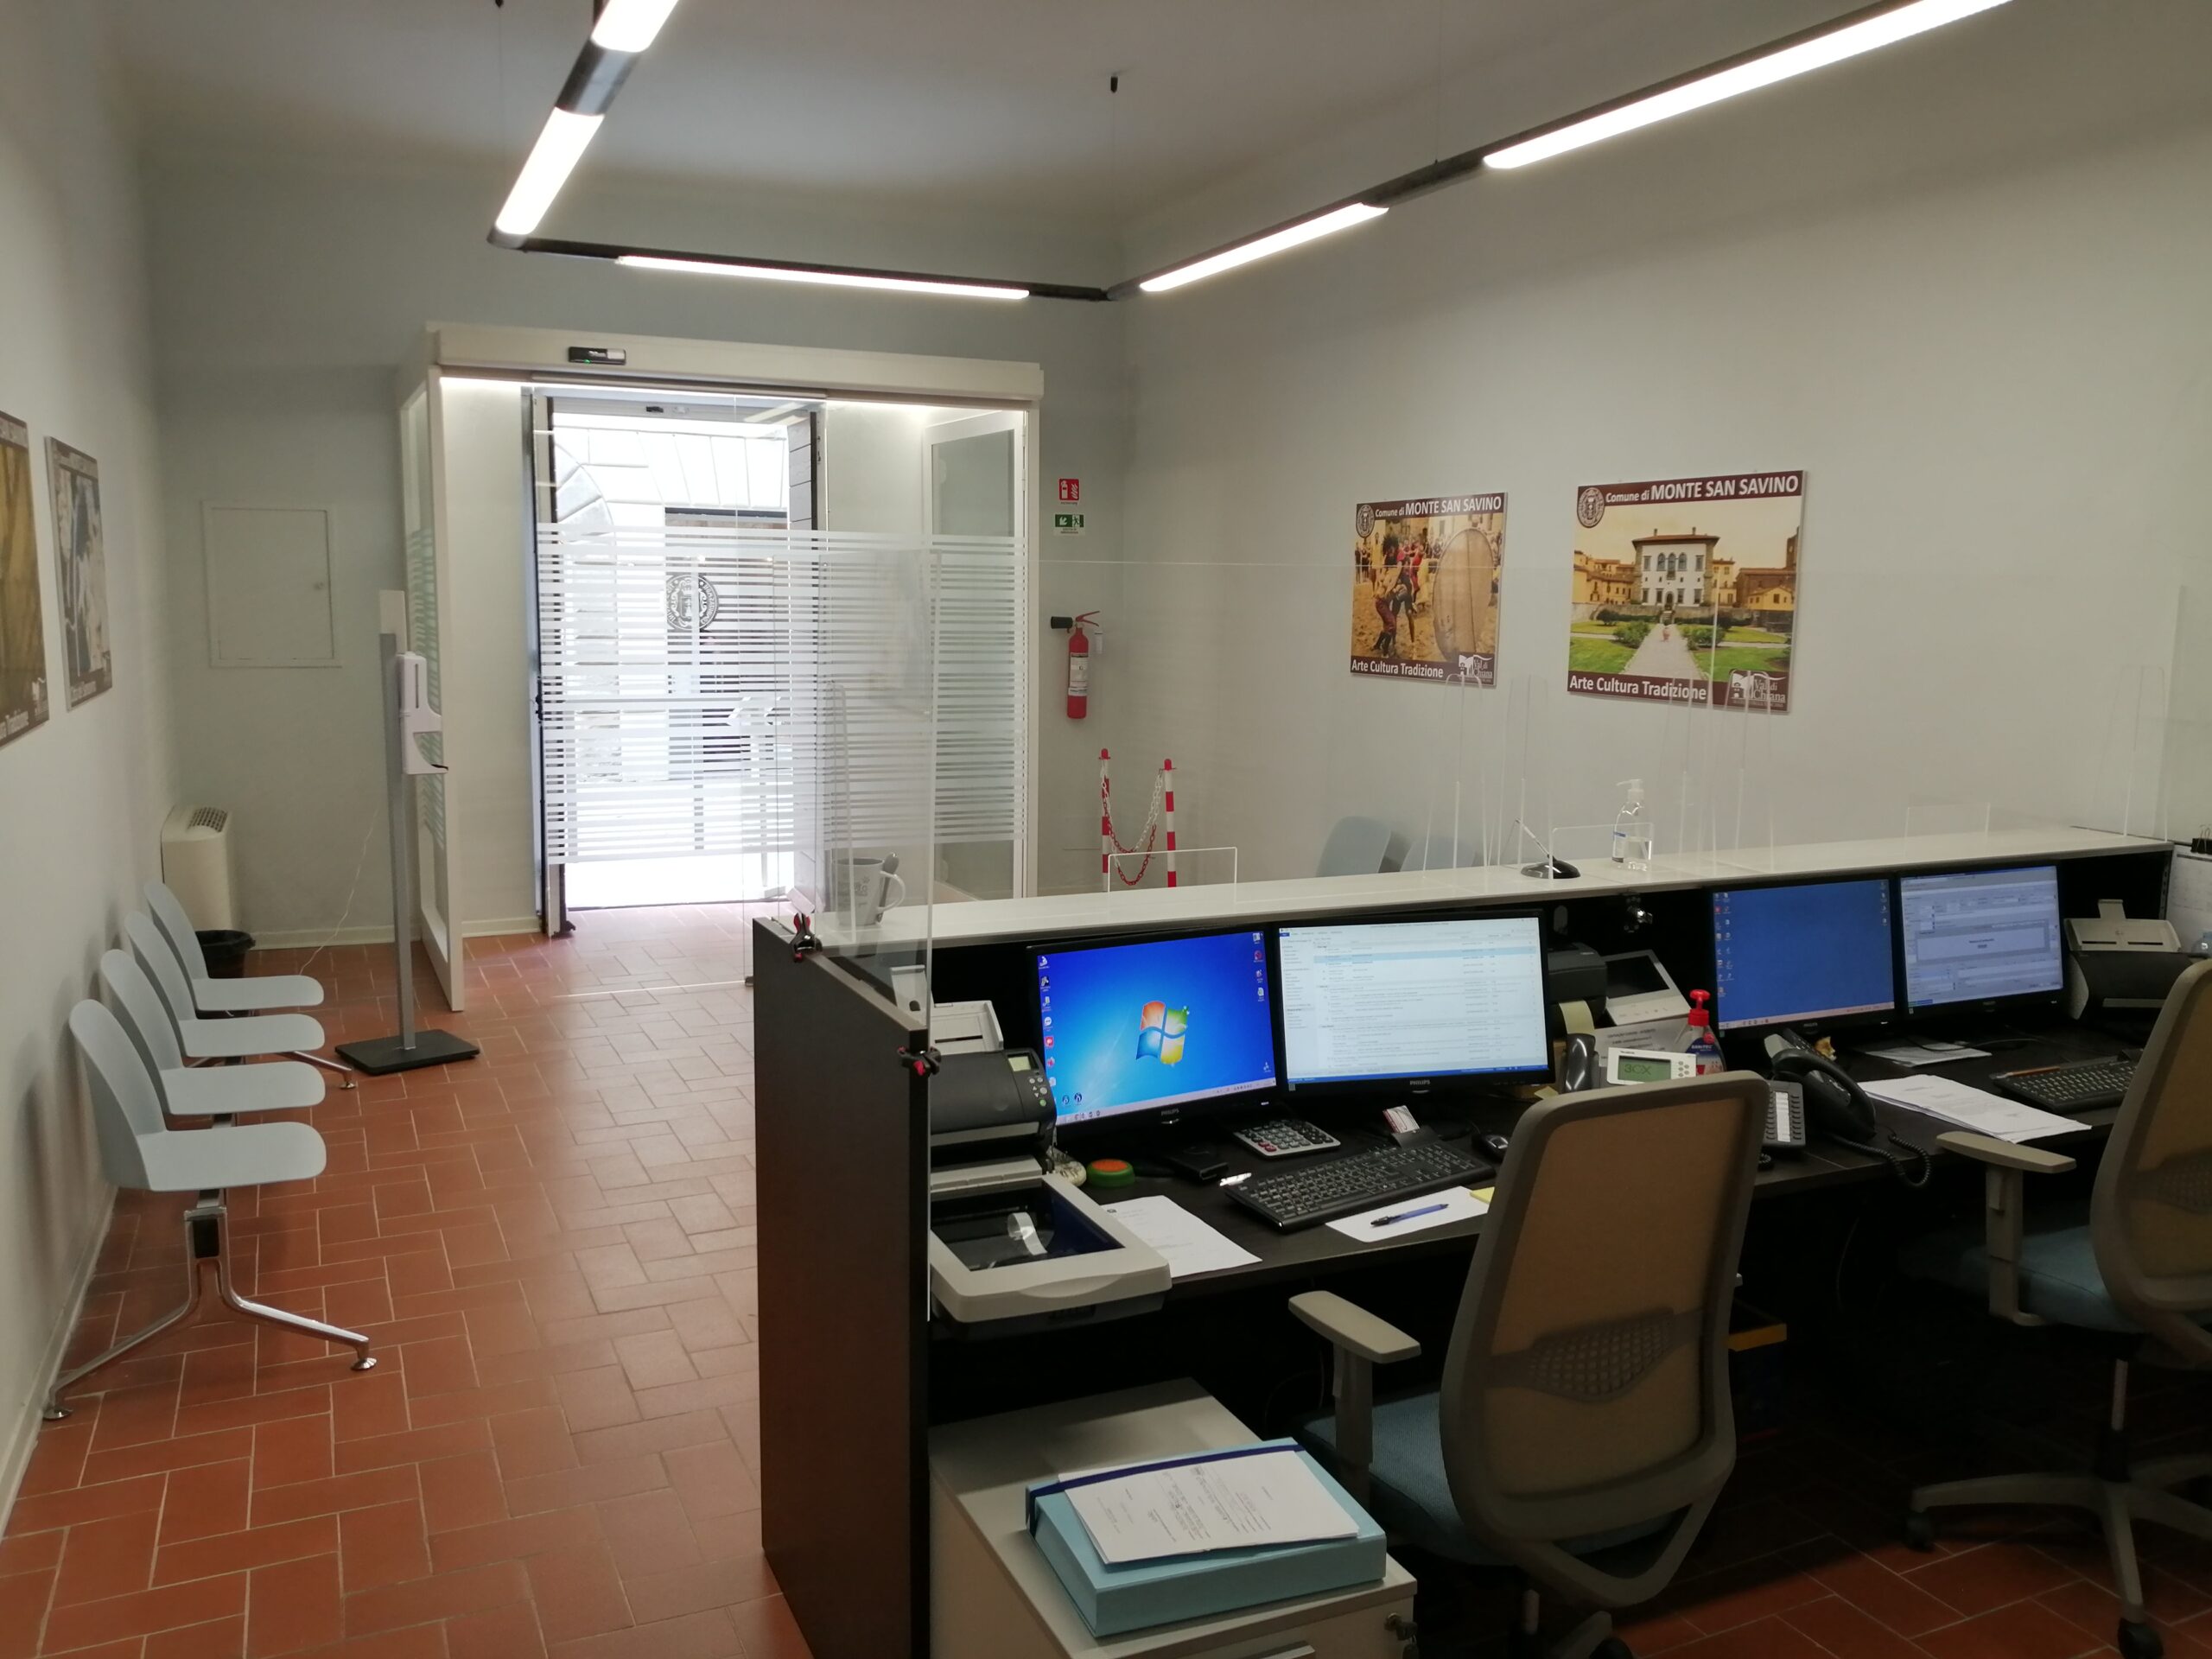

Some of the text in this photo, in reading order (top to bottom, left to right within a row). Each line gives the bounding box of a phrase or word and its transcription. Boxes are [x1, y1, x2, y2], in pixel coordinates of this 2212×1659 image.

[1605, 475, 1798, 503] Comune di MONTE SAN SAVINO
[1375, 496, 1502, 518] Comune di MONTE SAN SAVINO
[1351, 659, 1444, 678] Arte Cultura Tradizione
[1569, 675, 1707, 701] Arte Cultura Tradizione
[1754, 689, 1785, 703] Chana
[1624, 1063, 1651, 1076] 3CX
